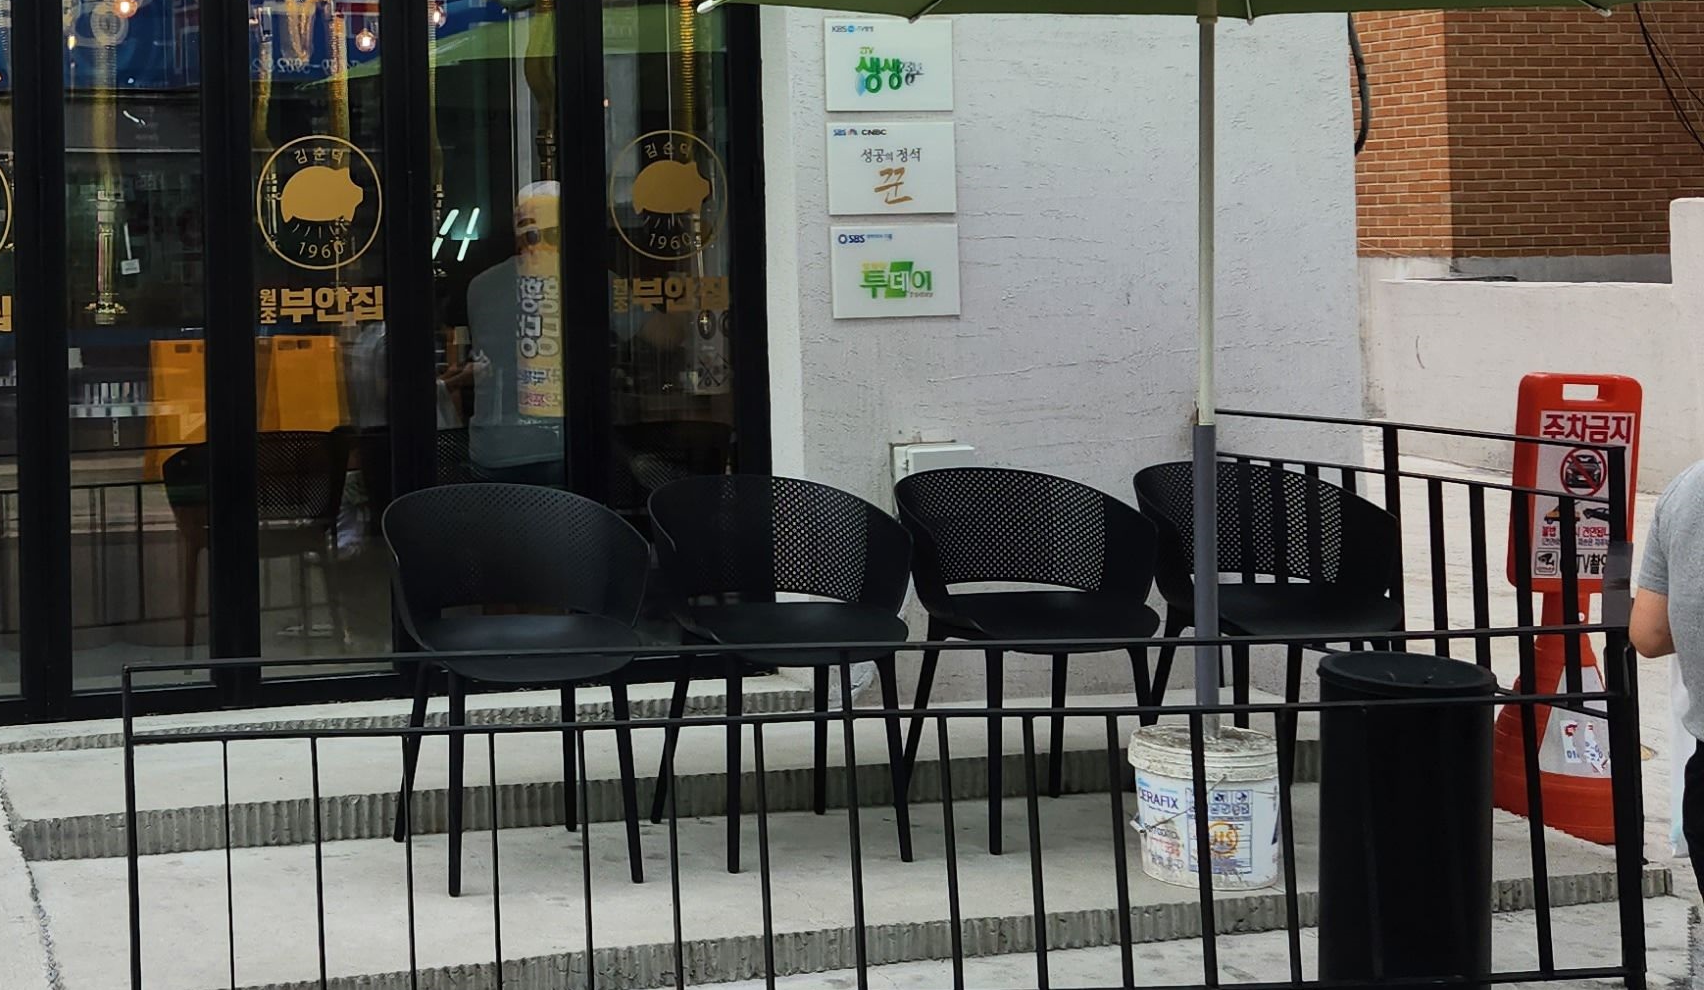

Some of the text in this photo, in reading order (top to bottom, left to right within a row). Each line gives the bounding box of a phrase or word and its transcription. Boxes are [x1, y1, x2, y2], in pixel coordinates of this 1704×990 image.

[294, 146, 345, 165] 김순덕
[896, 147, 922, 163] 정석
[649, 232, 692, 251] 1960
[849, 235, 865, 243] SBS
[298, 240, 345, 260] 1960
[859, 267, 932, 299] 투데이
[280, 286, 384, 323] 부안집
[1543, 414, 1632, 444] 주차금지
